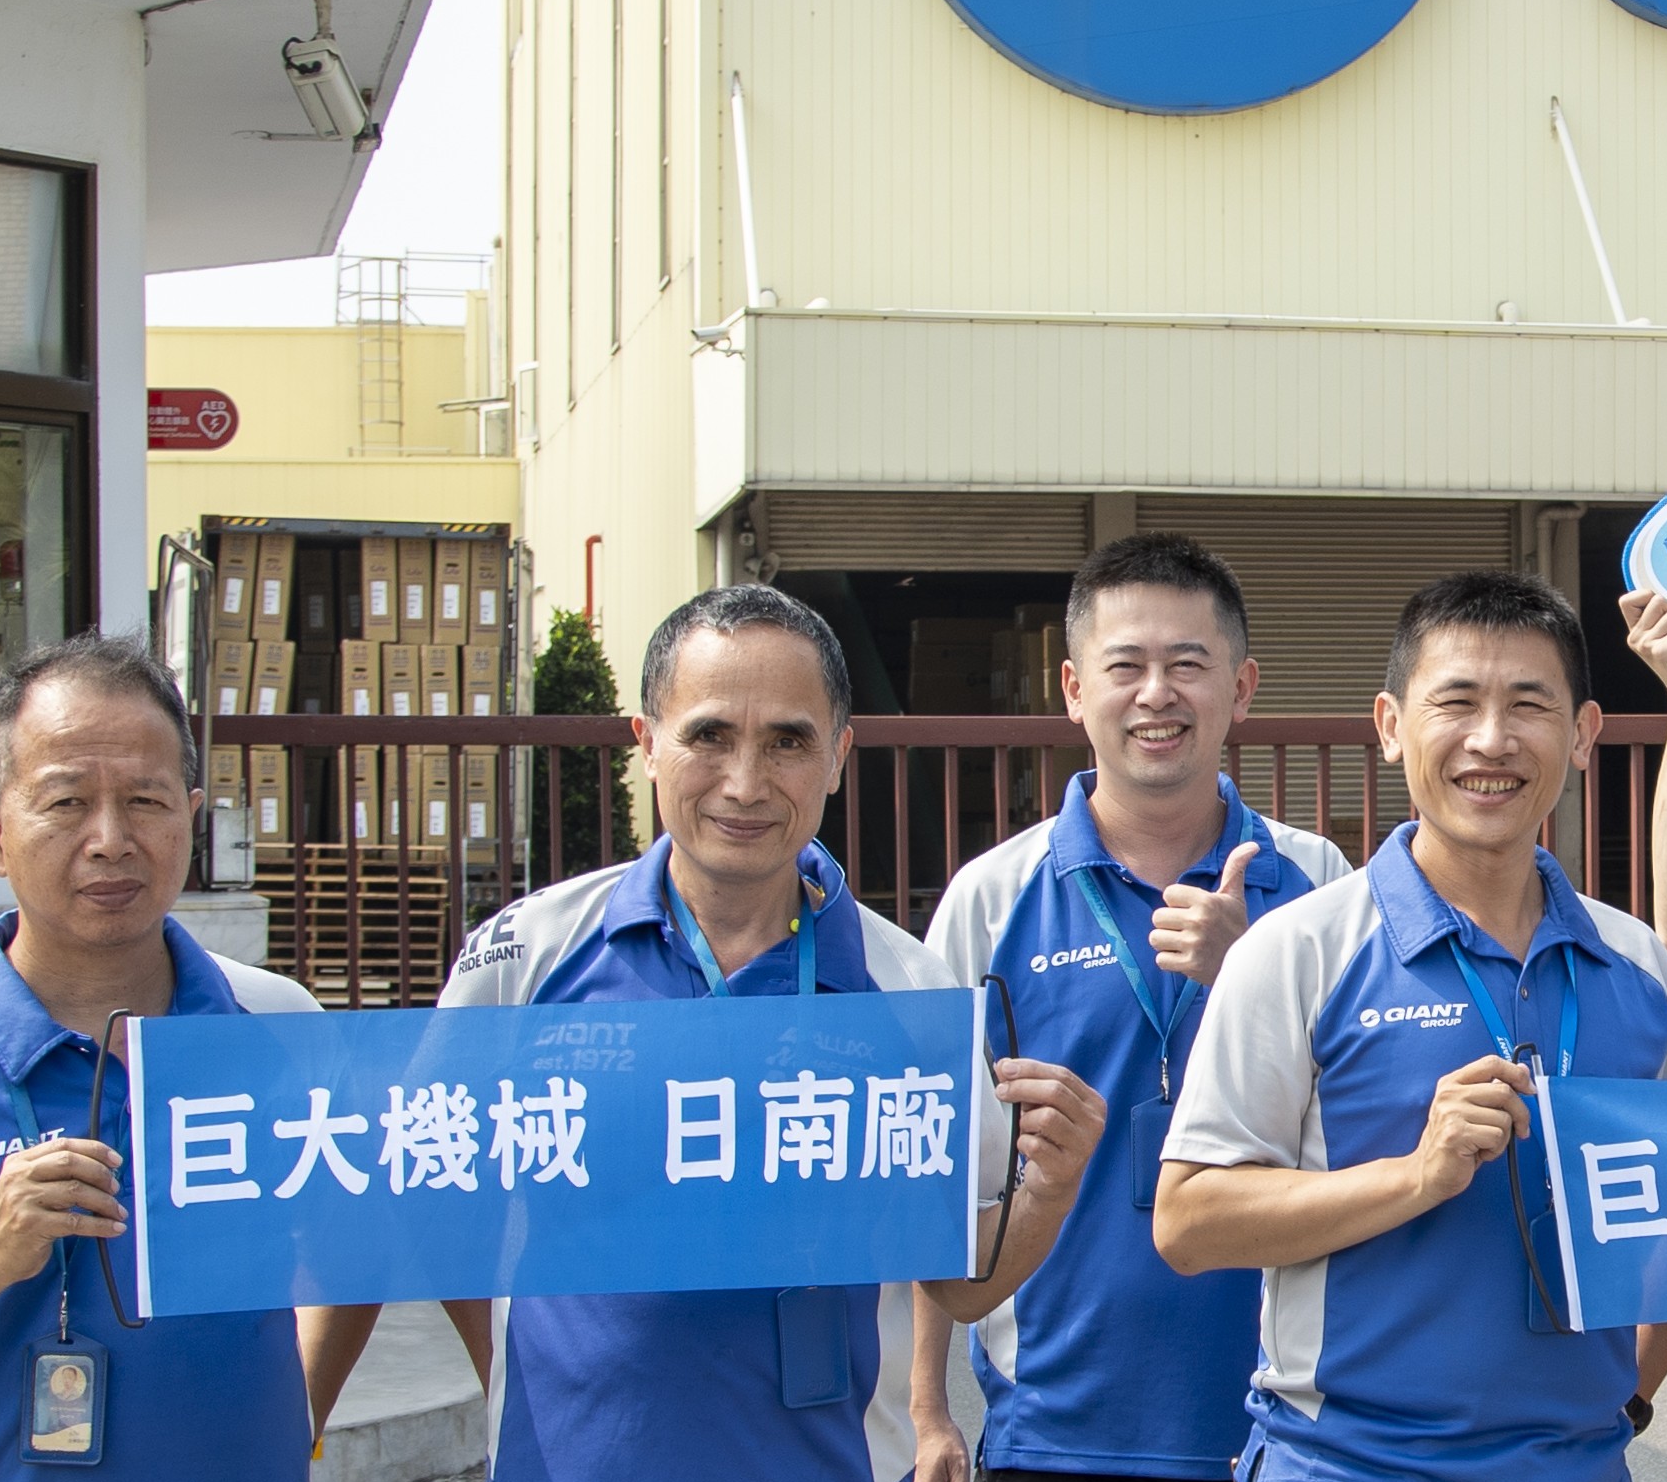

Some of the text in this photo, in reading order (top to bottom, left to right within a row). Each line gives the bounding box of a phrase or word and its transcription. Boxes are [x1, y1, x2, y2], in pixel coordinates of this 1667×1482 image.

[201, 400, 227, 411] AED
[458, 943, 525, 976] RIDE GIANT
[1051, 943, 1111, 967] GIAN
[1383, 1002, 1469, 1023] GIANT
[1420, 1017, 1462, 1029] GROUP
[168, 1065, 956, 1208] 巨大機械 日南廠
